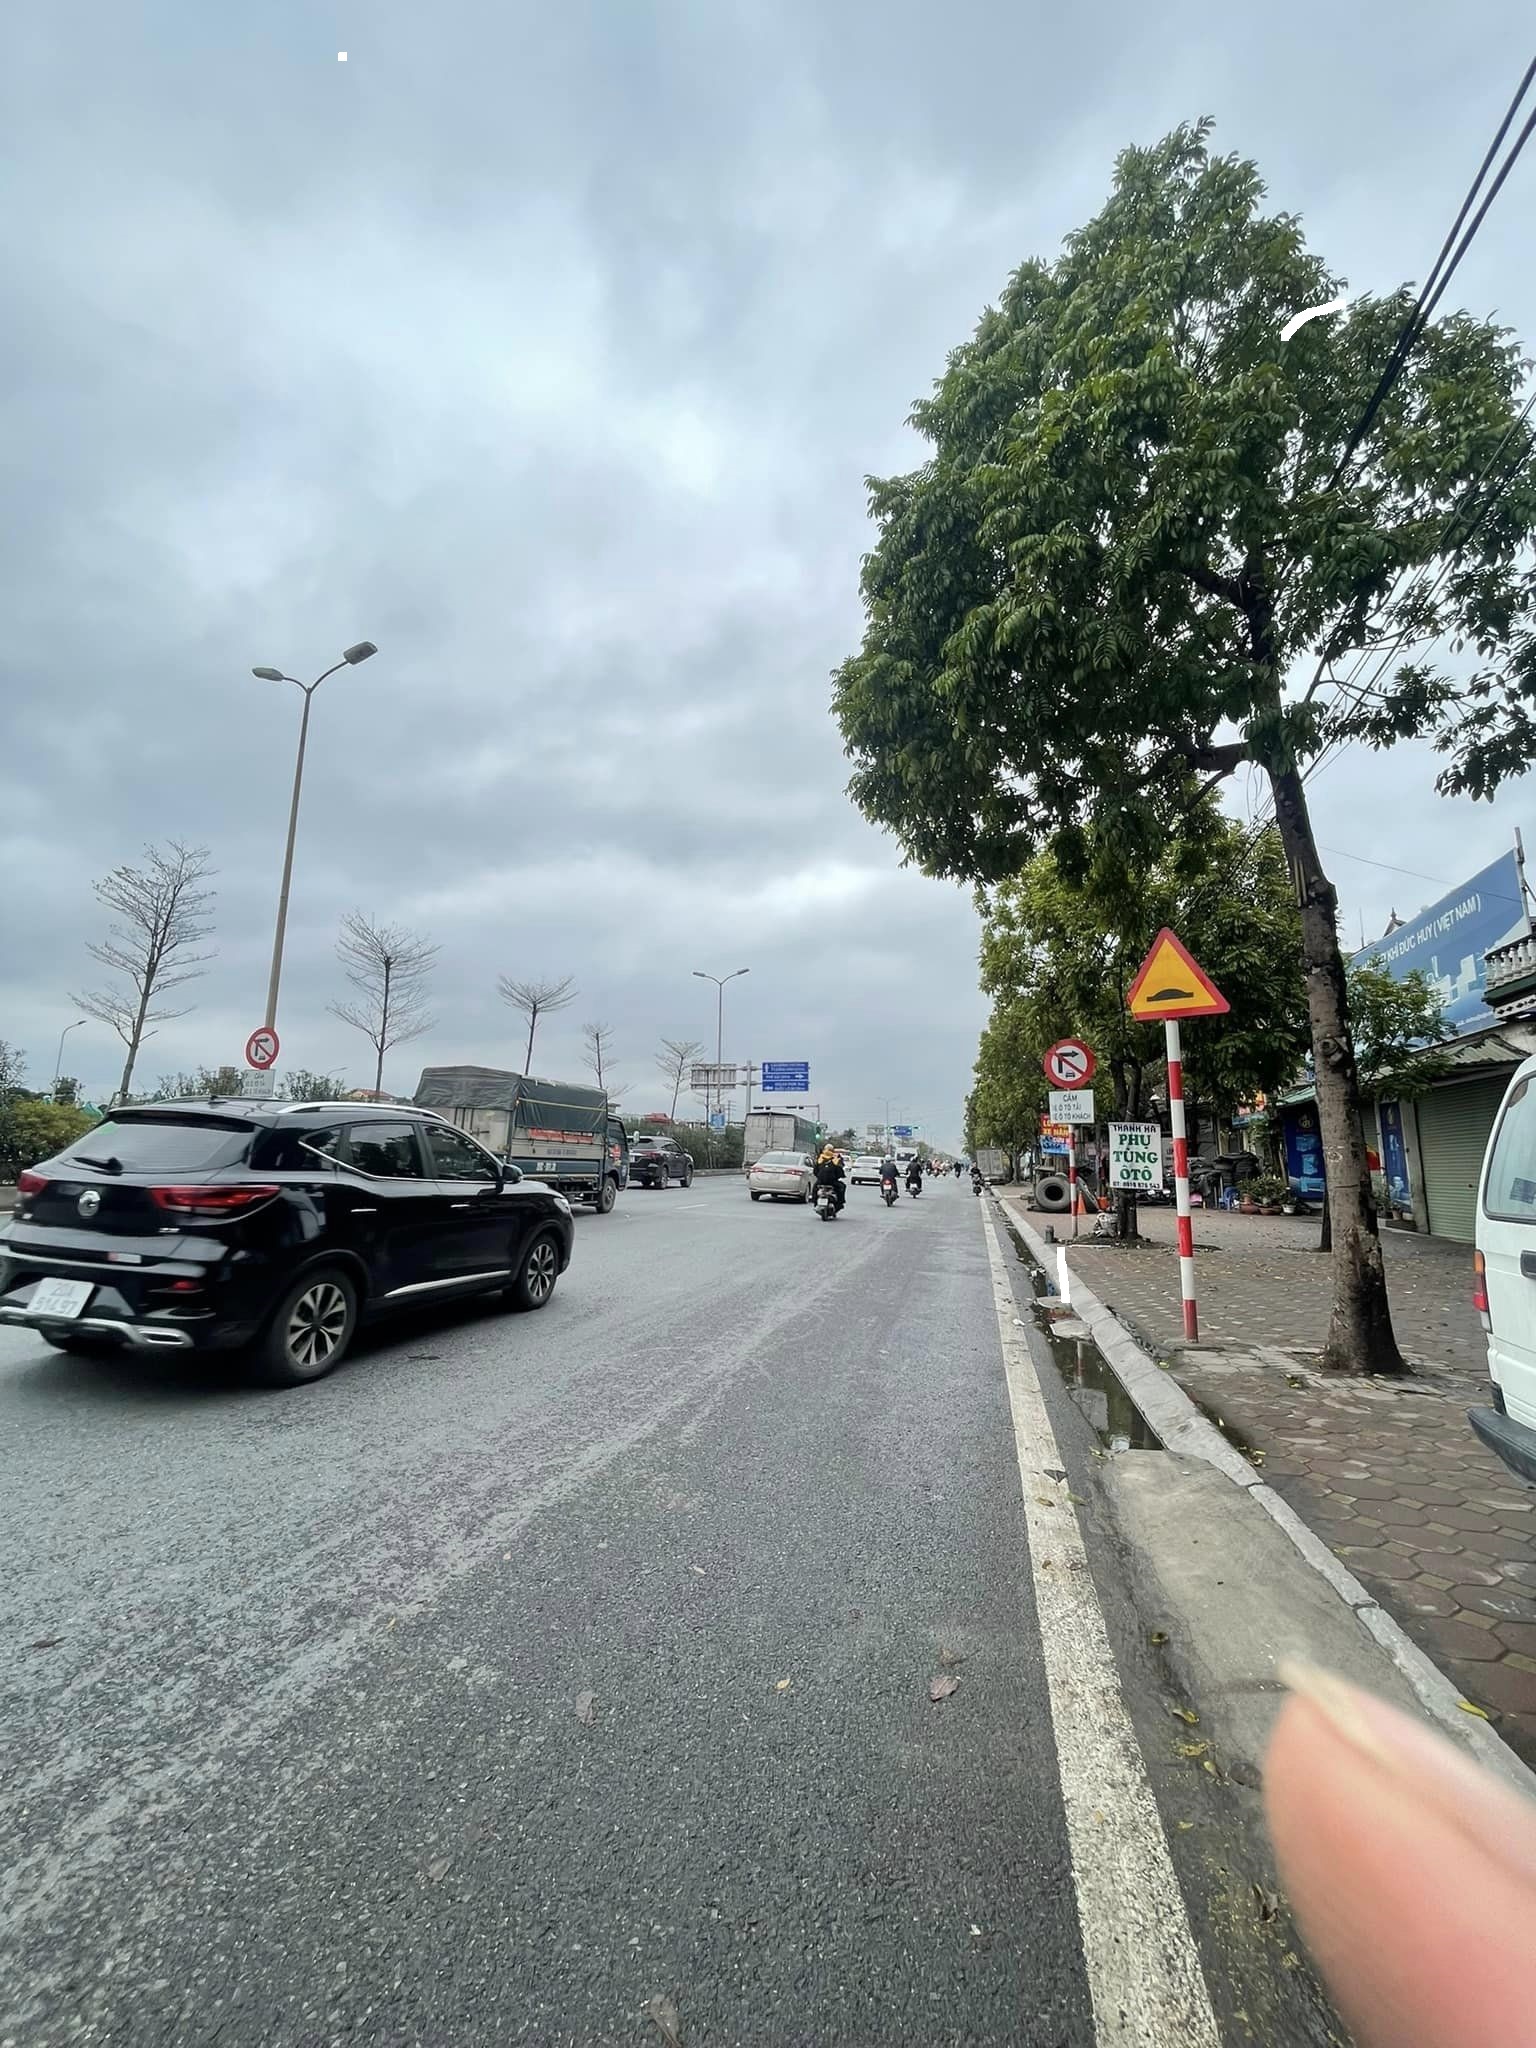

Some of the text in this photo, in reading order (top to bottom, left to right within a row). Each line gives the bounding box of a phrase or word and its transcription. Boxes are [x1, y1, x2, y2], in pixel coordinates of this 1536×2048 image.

[1416, 922, 1433, 944] HUY
[1113, 1124, 1141, 1132] THANH
[1119, 1134, 1151, 1149] PHỤ
[1113, 1147, 1158, 1164] TÙNG
[1120, 1165, 1152, 1181] ÔTÔ
